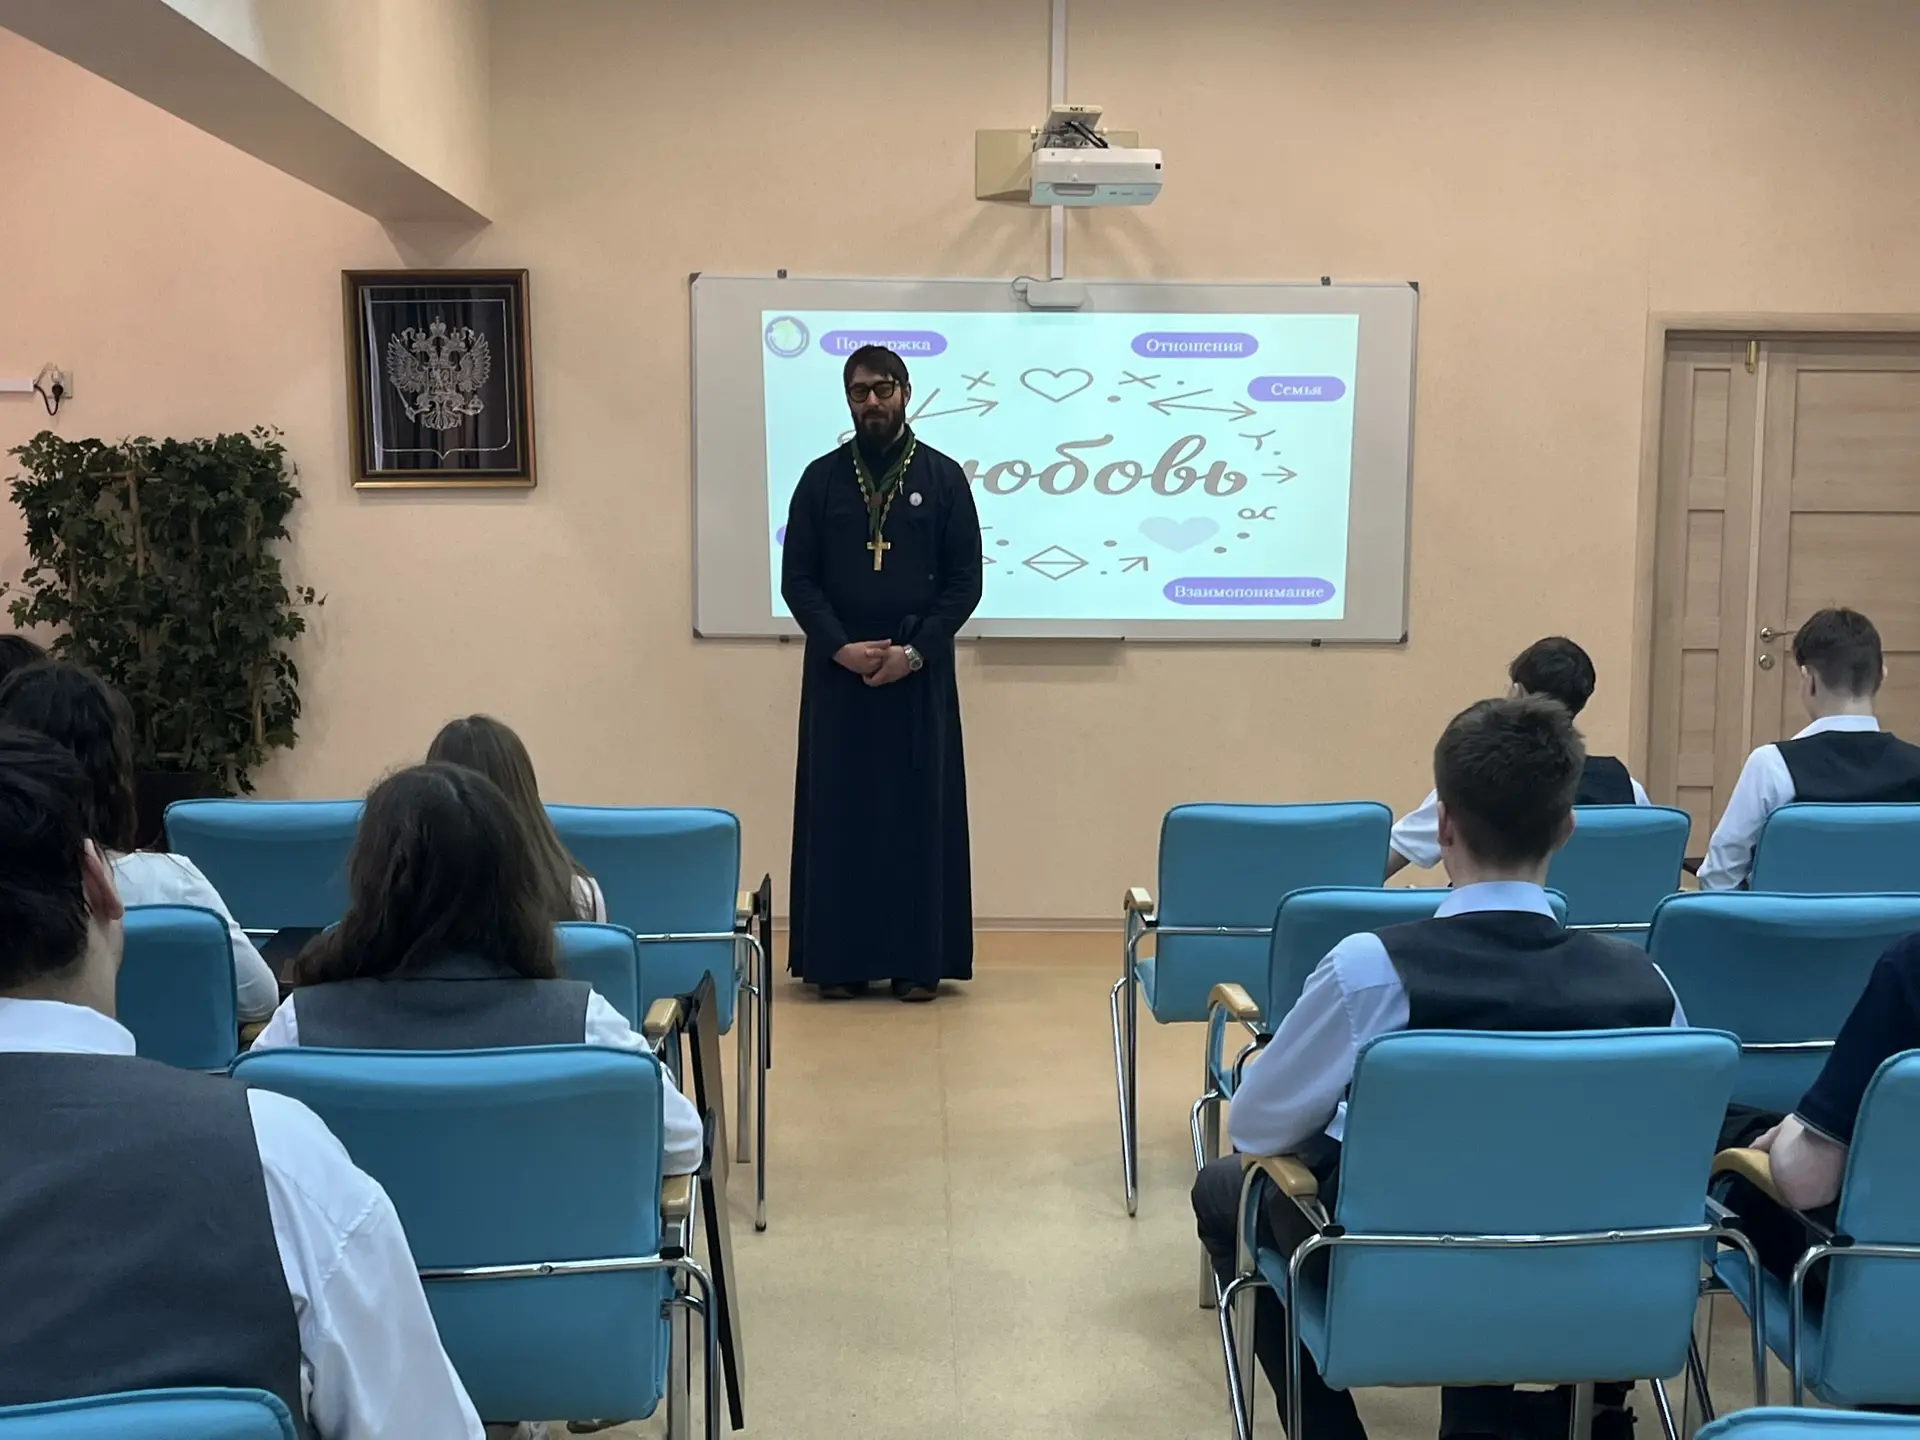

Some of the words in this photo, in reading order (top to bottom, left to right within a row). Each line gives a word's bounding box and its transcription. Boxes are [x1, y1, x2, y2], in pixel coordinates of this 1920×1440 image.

[1146, 338, 1243, 352] Отношения
[1270, 382, 1322, 396] Семья
[962, 433, 1248, 497] юбовь
[1174, 585, 1325, 598] Взаимопонимание
